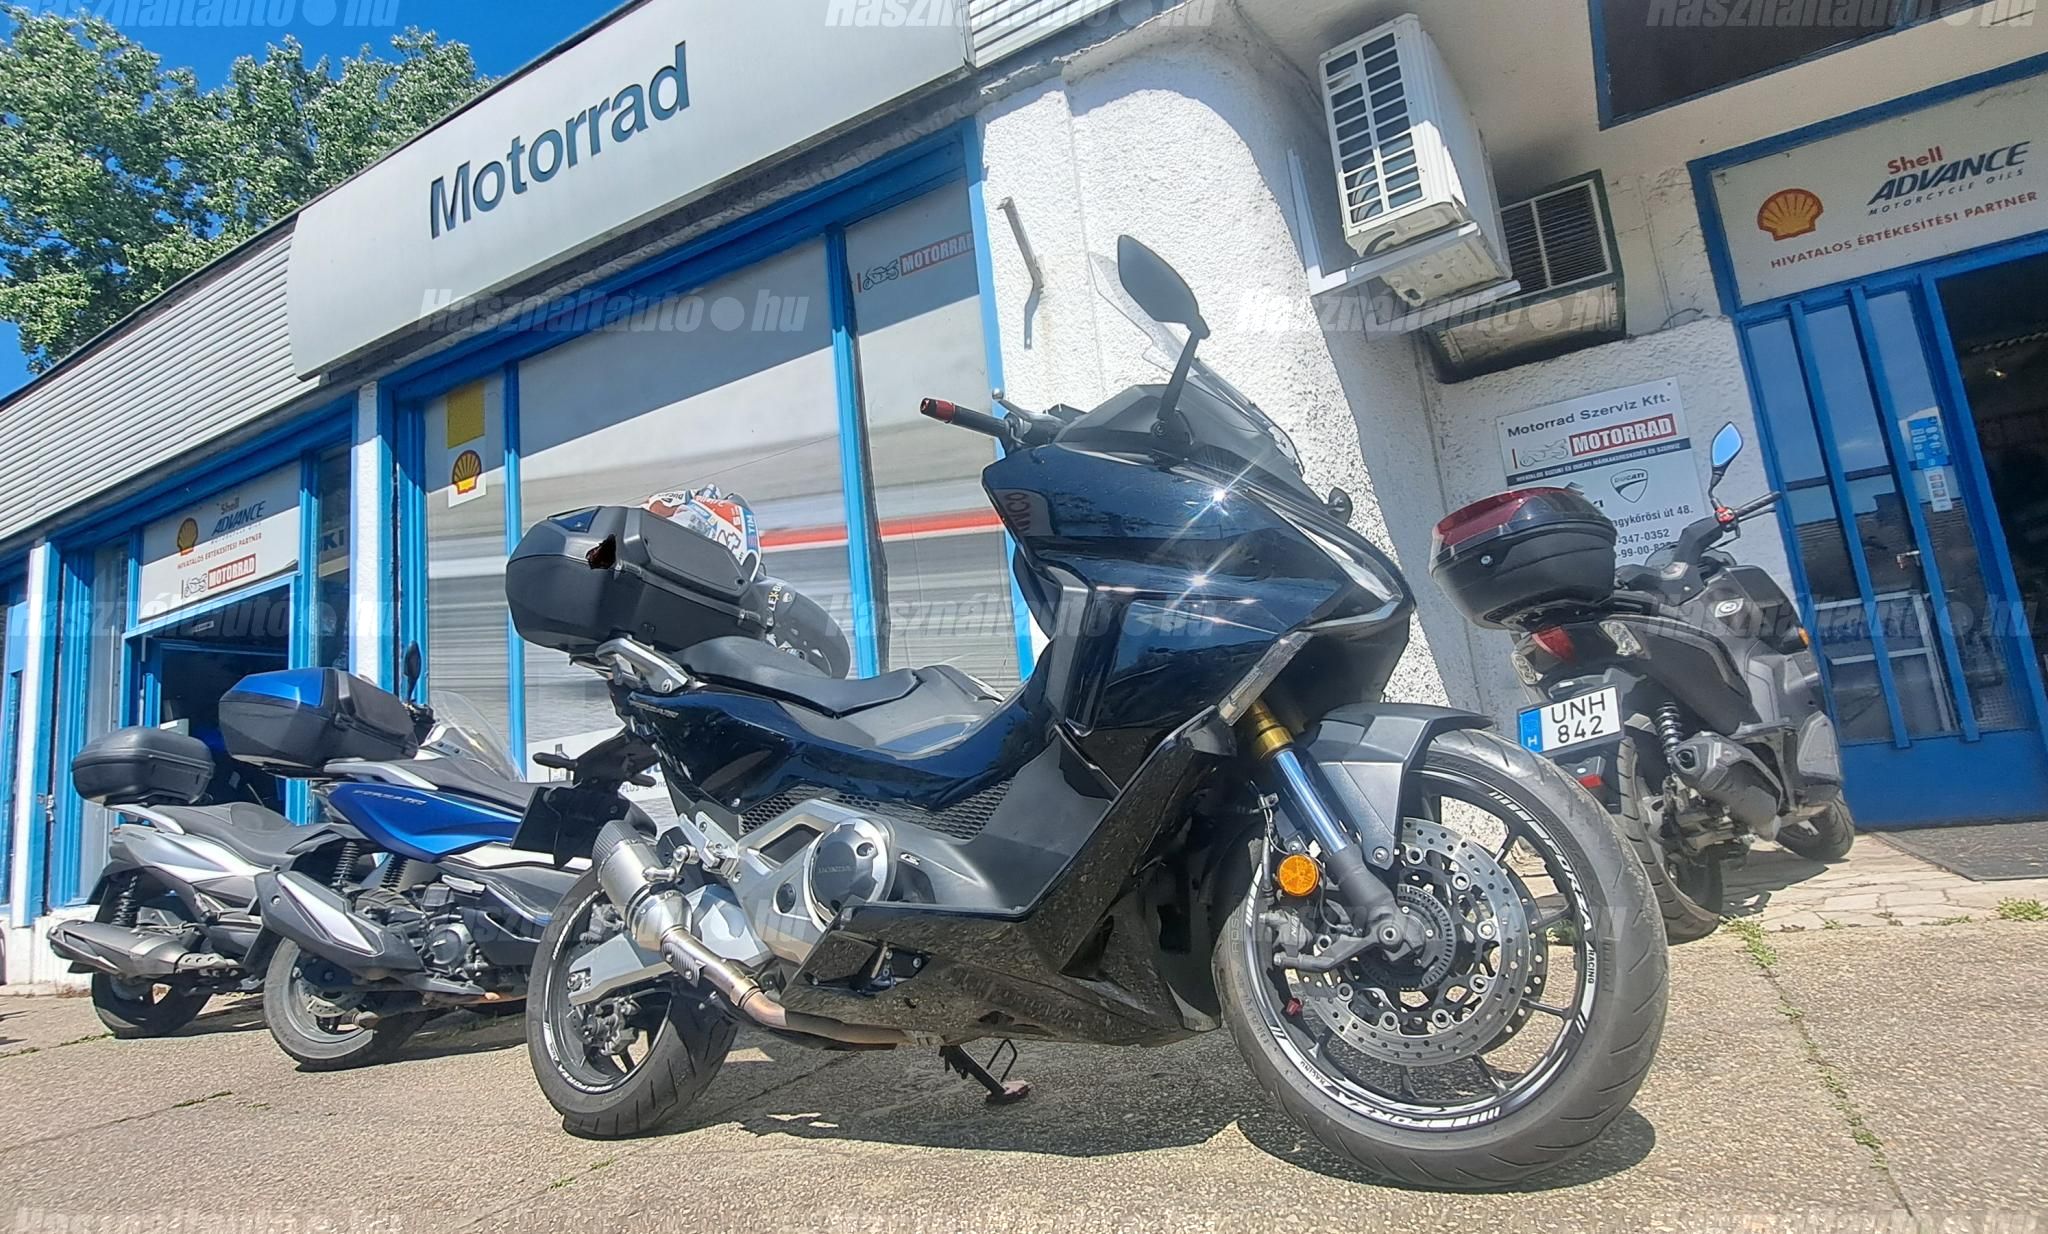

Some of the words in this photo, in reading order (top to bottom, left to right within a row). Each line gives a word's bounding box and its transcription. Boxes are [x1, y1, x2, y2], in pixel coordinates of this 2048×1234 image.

[430, 40, 690, 240] Motorrad
[1867, 140, 2031, 206] ADVANCE
[1887, 145, 1944, 175] Shell
[1868, 181, 1975, 216] MOTORCYCLE
[1986, 167, 2024, 185] OILS
[1771, 239, 1852, 268] HIVATALOS
[1964, 191, 2038, 218] PARTNER
[1507, 413, 1575, 437] Motorrad
[1579, 400, 1637, 420] Szerviz
[1641, 393, 1671, 408] Kft.
[1572, 417, 1673, 454] MOTORRAD
[1614, 472, 1645, 484] DUCATI
[212, 500, 266, 536] ADVANCE
[221, 497, 239, 515] Shell
[1664, 507, 1675, 518] út
[1677, 504, 1694, 516] 48.
[209, 556, 255, 588] MOTORRAD
[1551, 692, 1605, 724] UNH
[1528, 734, 1538, 747] H
[1558, 715, 1603, 744] 842
[1587, 948, 1596, 985] RACING
